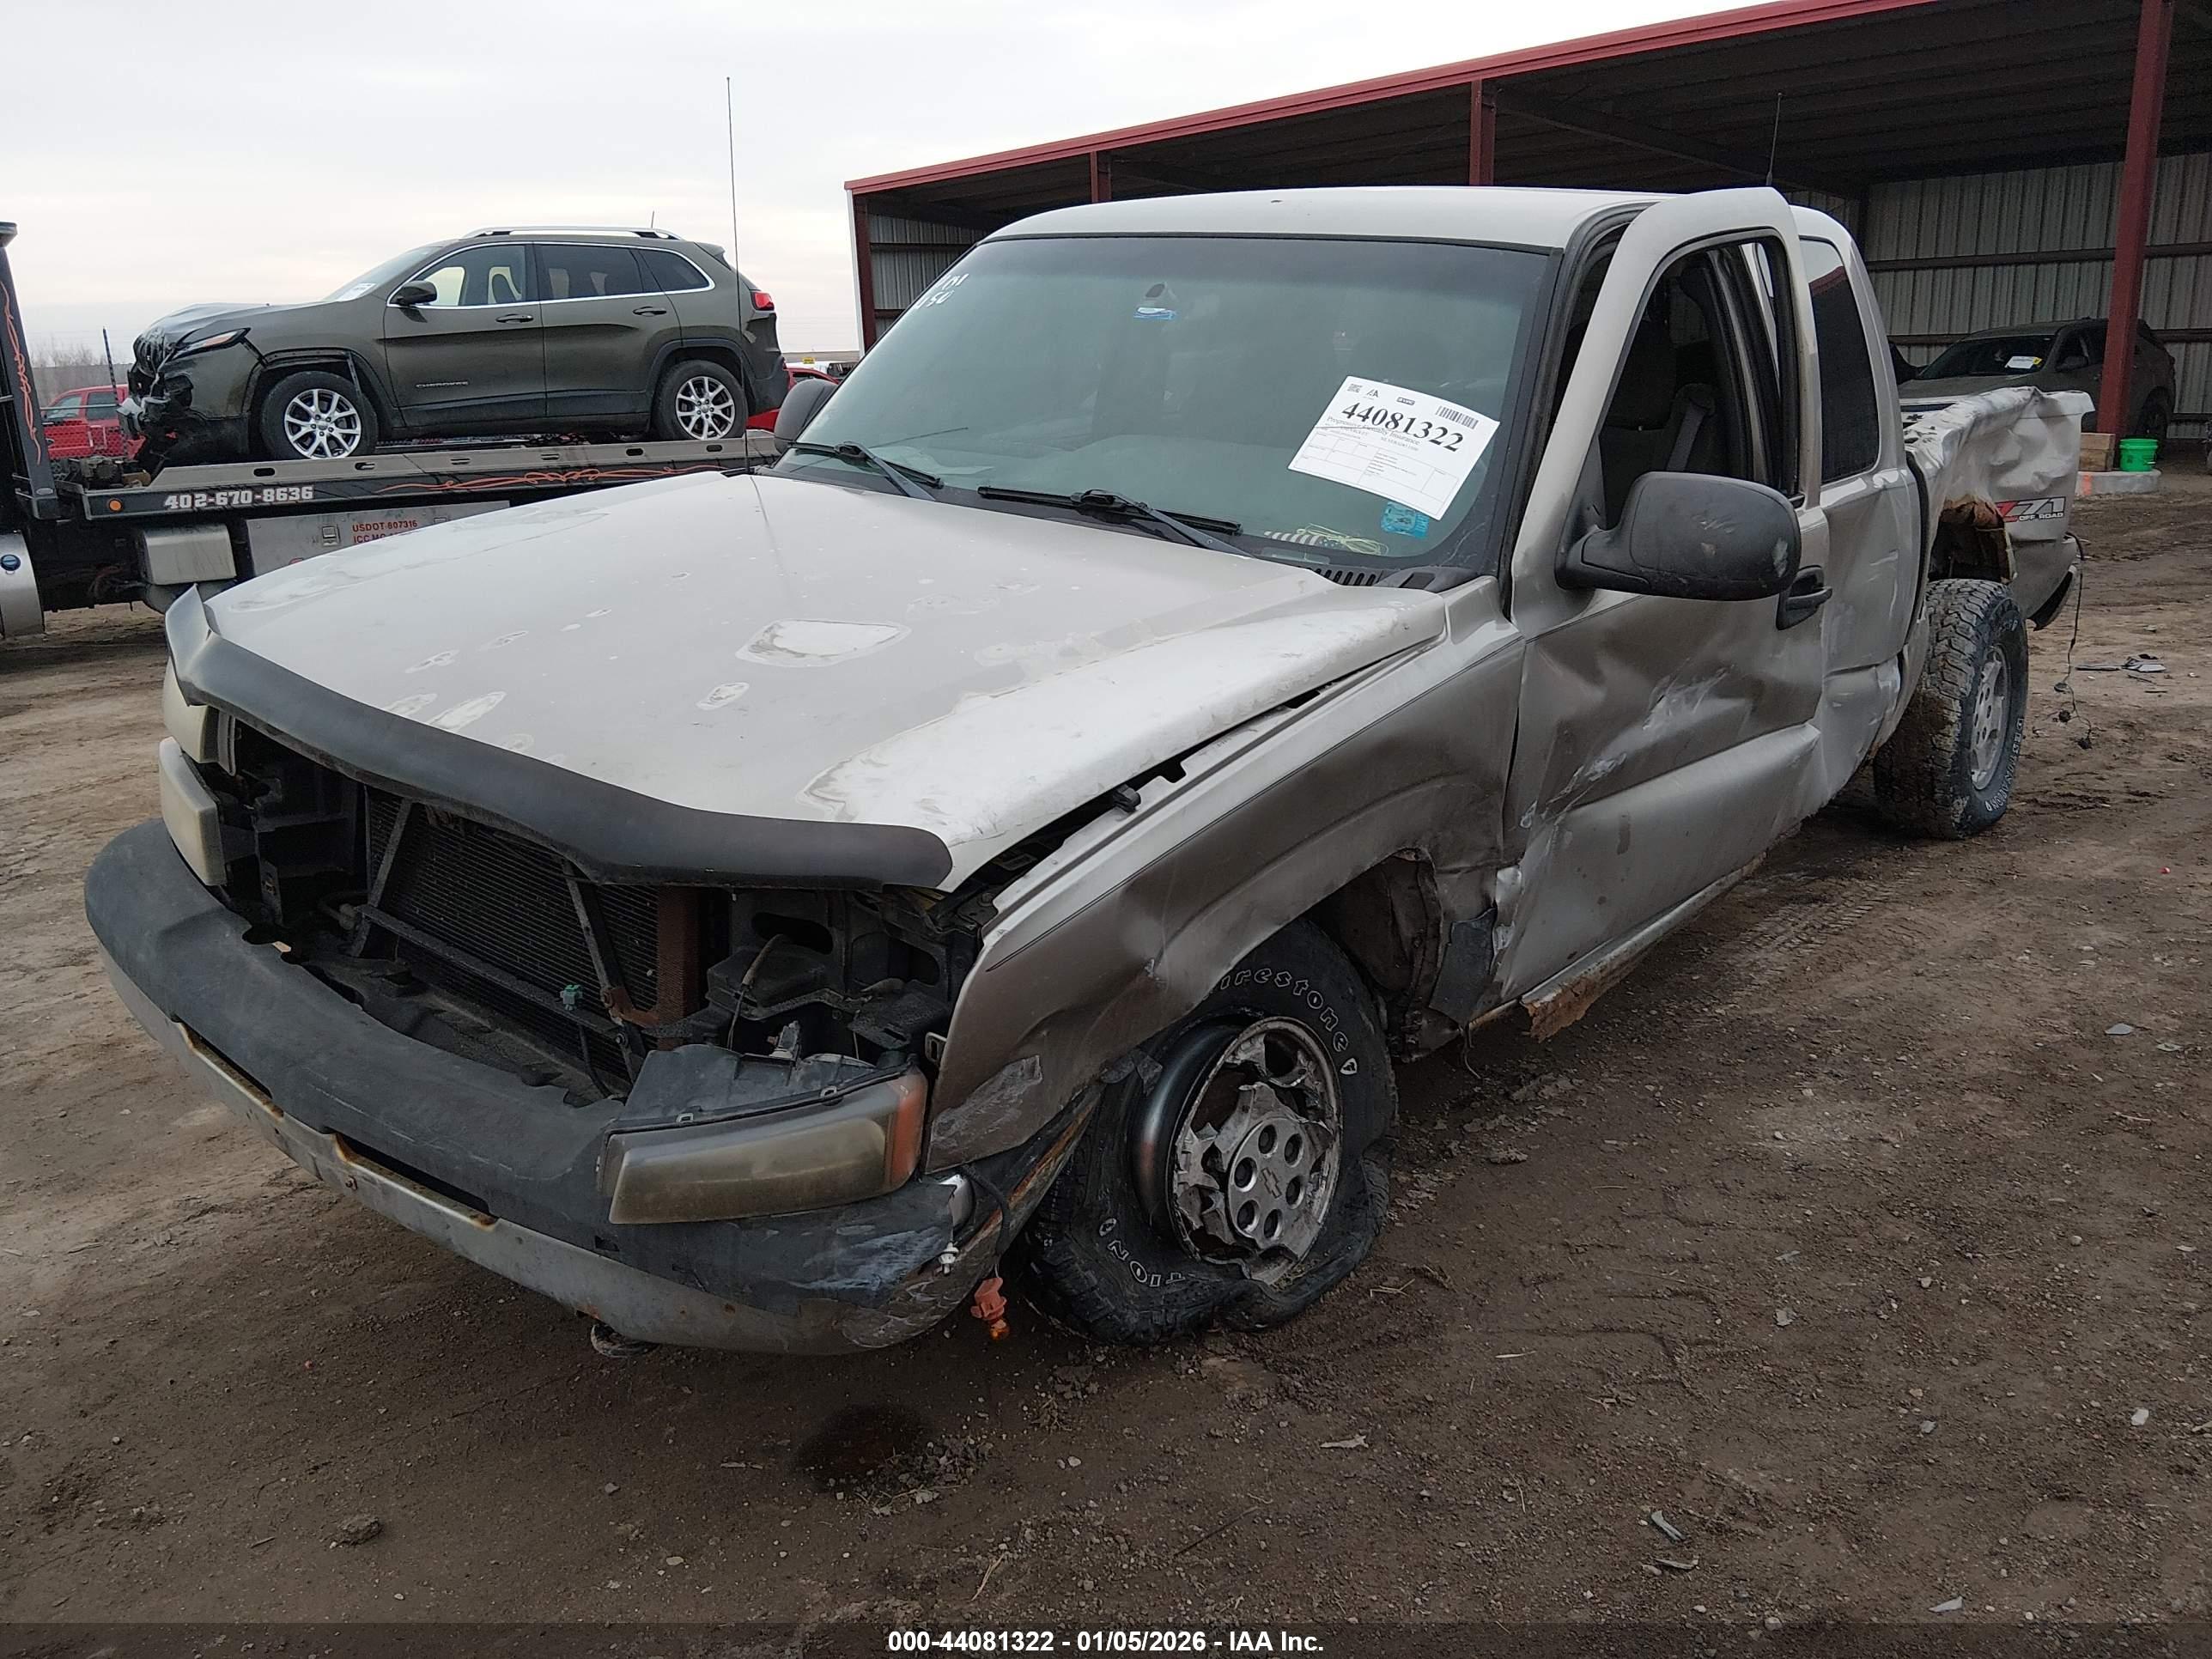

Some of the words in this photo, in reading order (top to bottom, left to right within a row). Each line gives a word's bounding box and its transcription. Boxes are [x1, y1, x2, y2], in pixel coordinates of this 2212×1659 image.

[1341, 402, 1464, 453] 44081322
[163, 486, 314, 509] 402-670-8636
[352, 521, 387, 532] USDOT
[388, 520, 418, 530] 807316
[1218, 968, 1349, 1053] irestone
